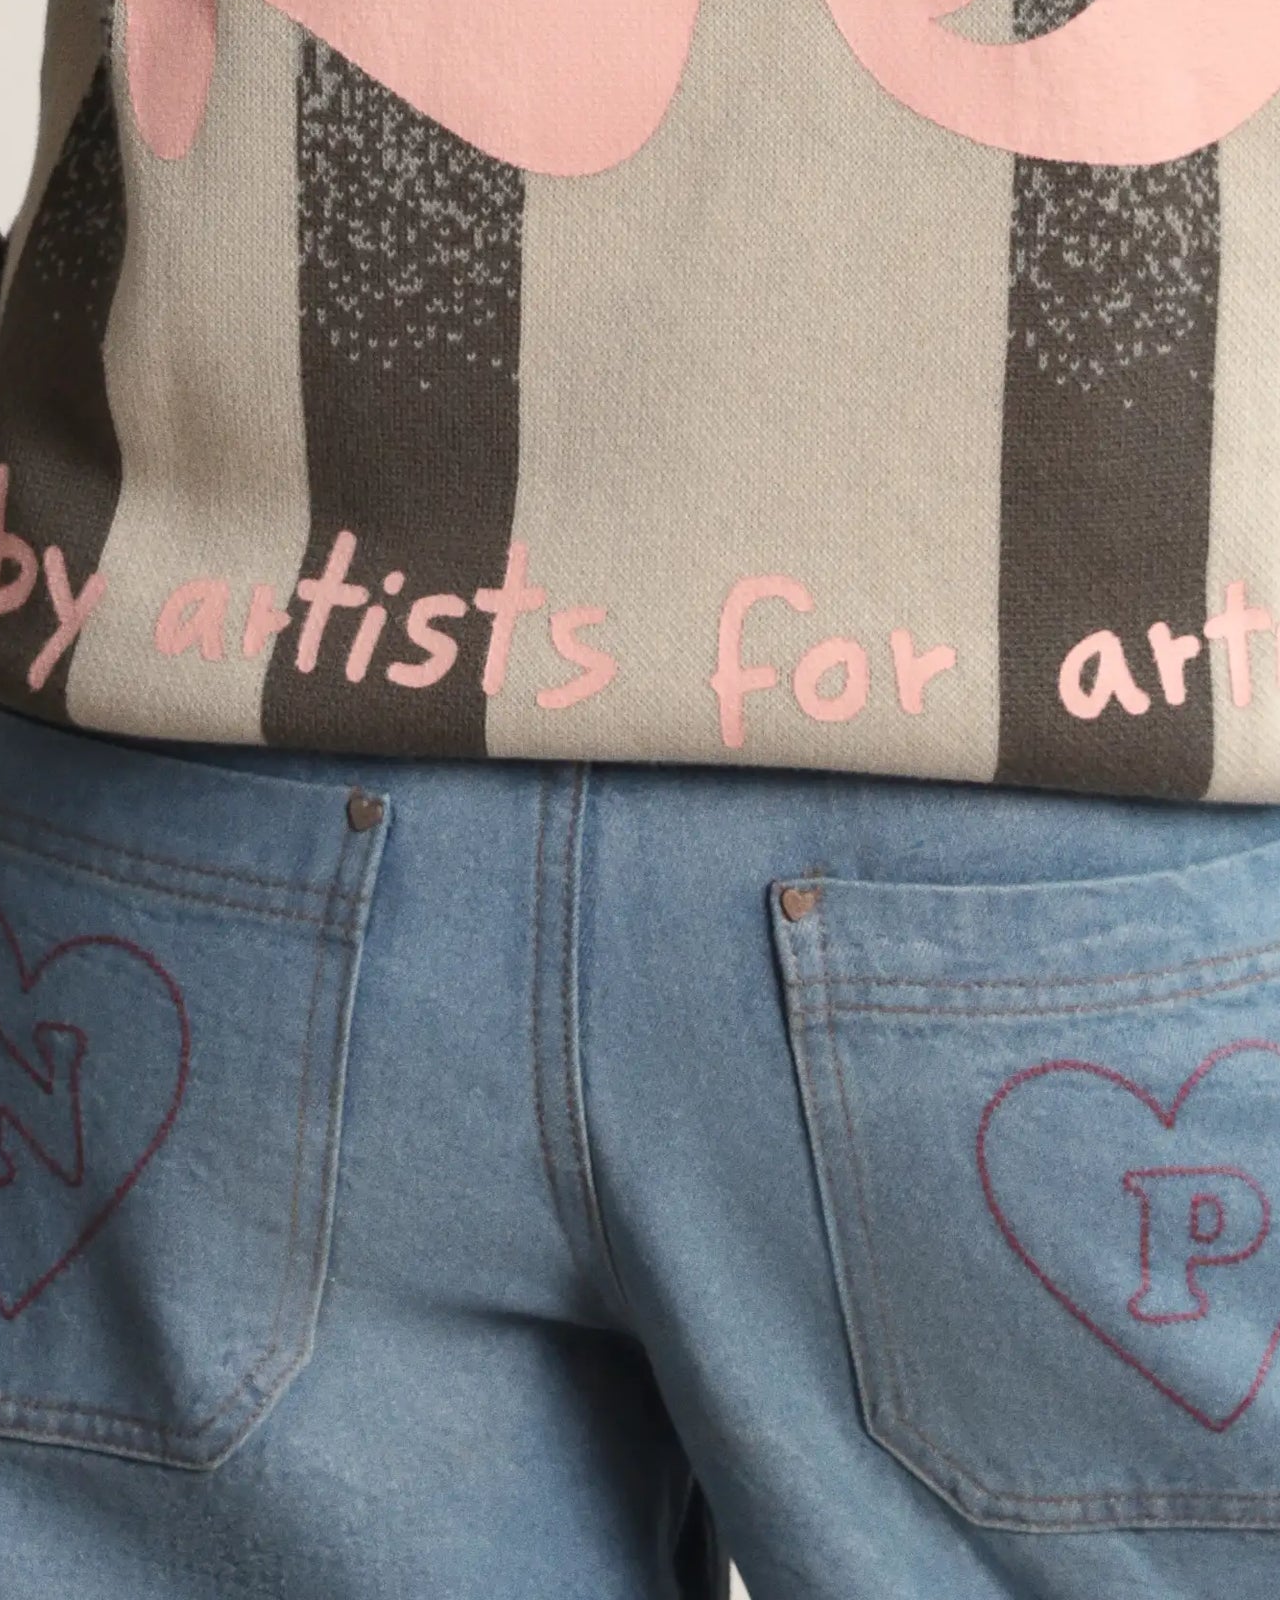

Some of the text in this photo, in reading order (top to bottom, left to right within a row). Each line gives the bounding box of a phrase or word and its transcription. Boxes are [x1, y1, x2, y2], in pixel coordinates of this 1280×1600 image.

[153, 530, 618, 710] artists
[710, 574, 957, 749] for
[1123, 1164, 1270, 1325] P
